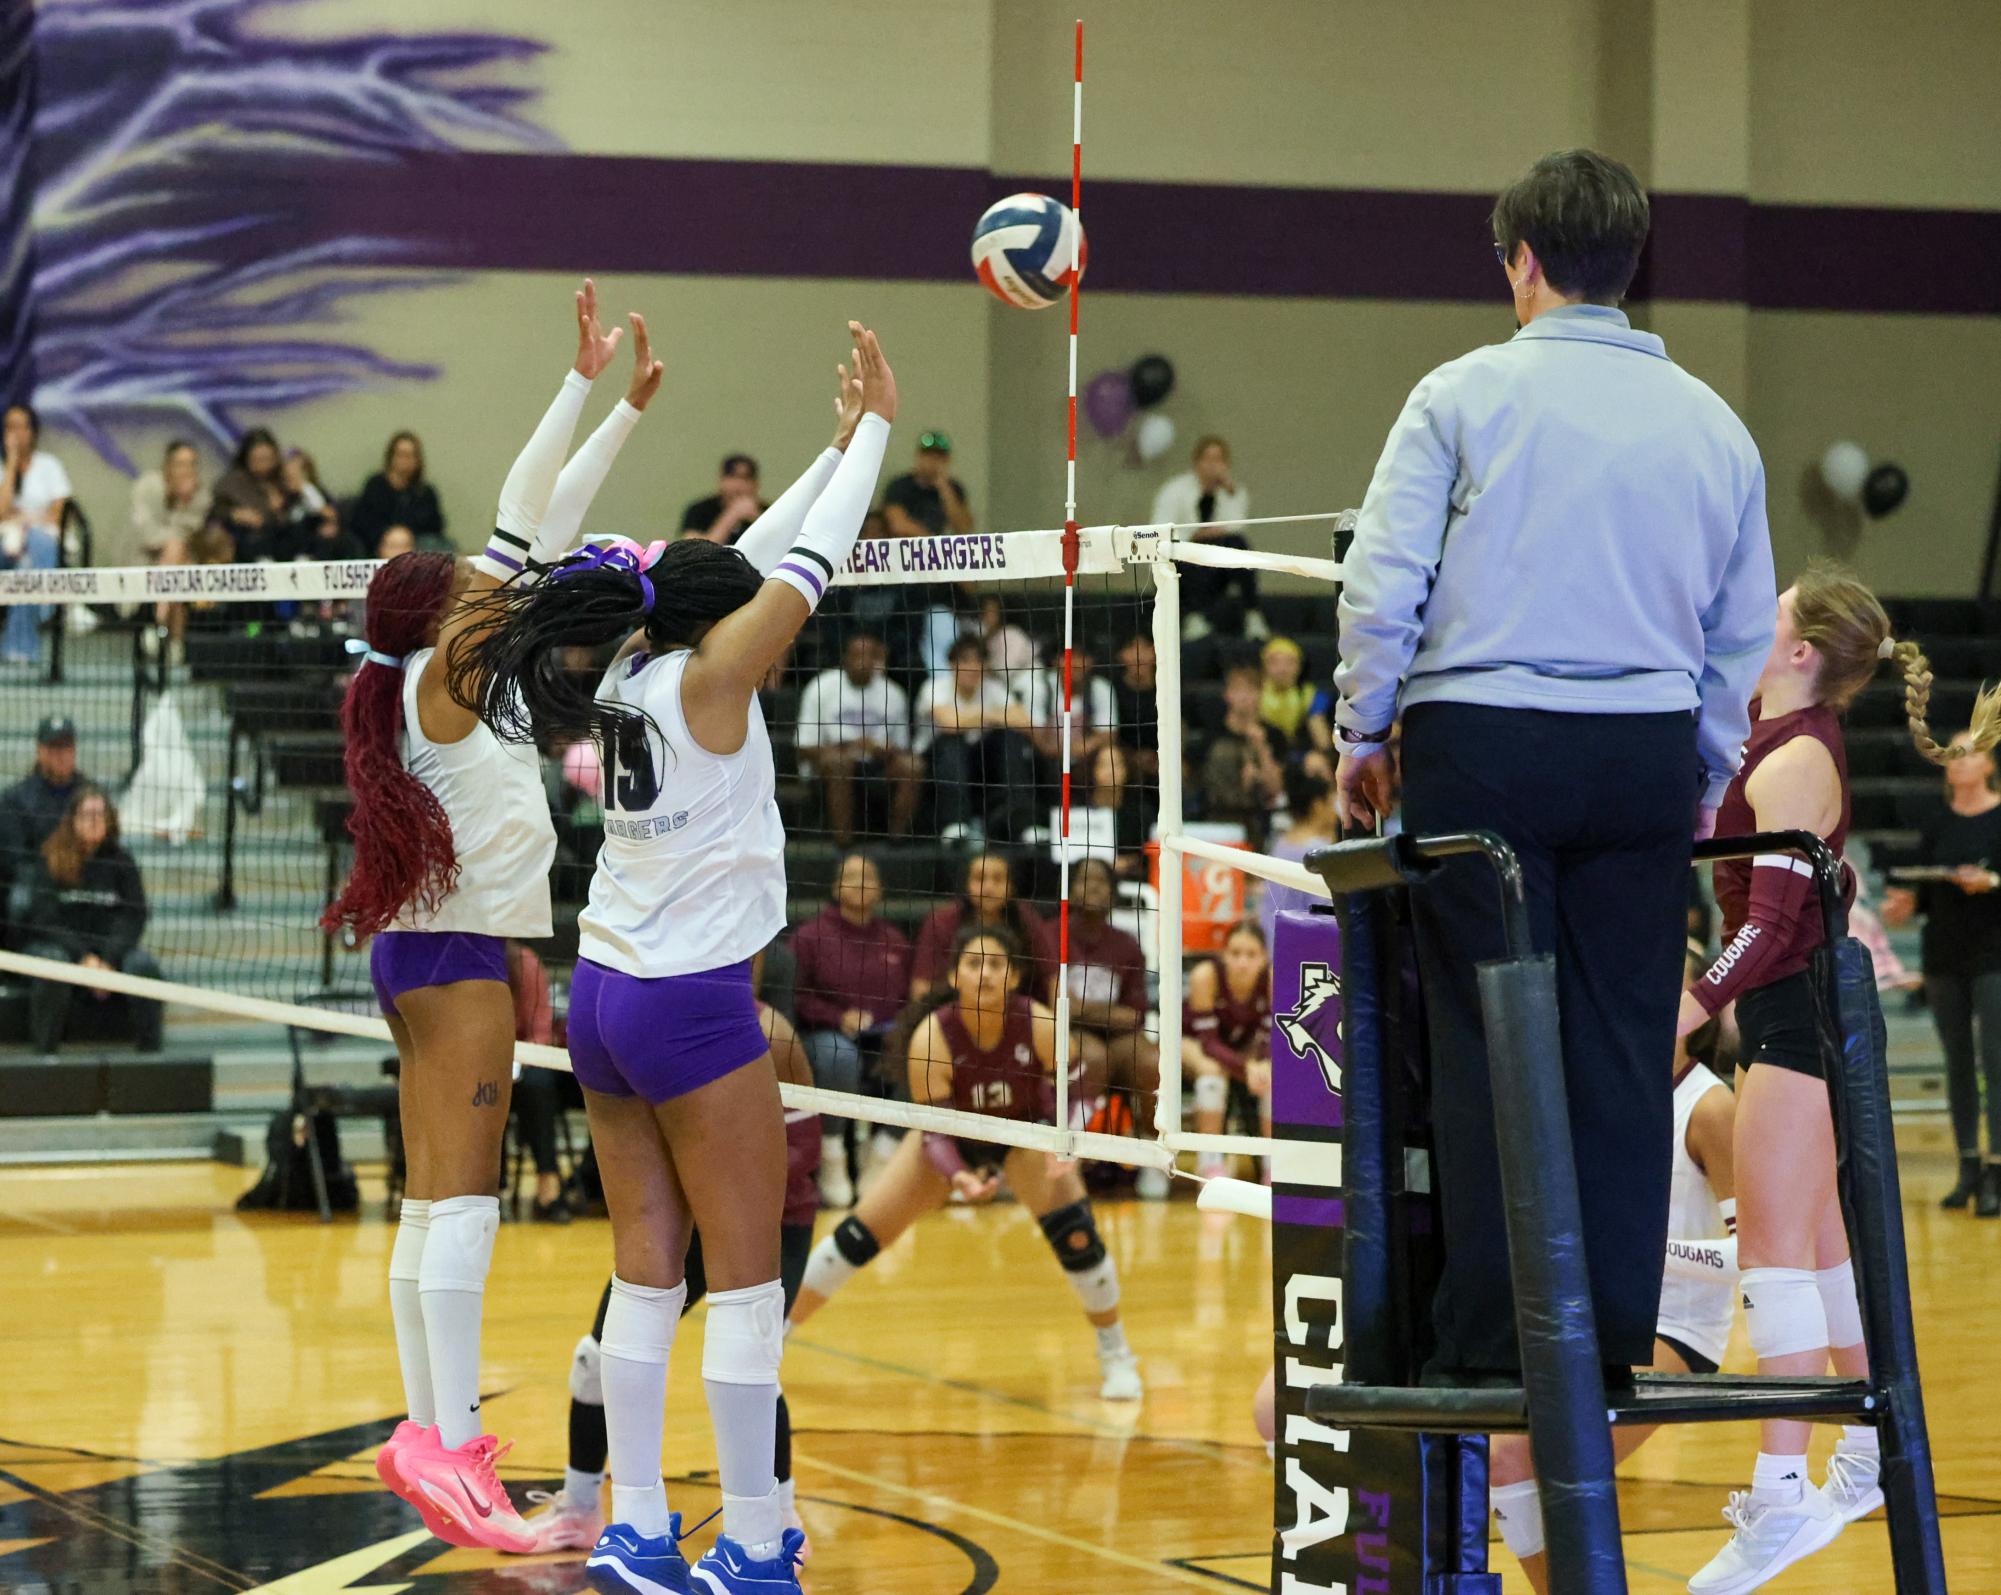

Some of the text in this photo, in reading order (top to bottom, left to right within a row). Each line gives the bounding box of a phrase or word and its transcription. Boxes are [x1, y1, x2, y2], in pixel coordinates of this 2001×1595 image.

[1138, 530, 1159, 539] Senoh
[900, 535, 1006, 571] CHARGERS
[324, 564, 376, 590] FULSHE
[1705, 922, 1762, 986] COUGARS
[1666, 1242, 1724, 1269] OUGARS
[1281, 1273, 1350, 1595] CHA
